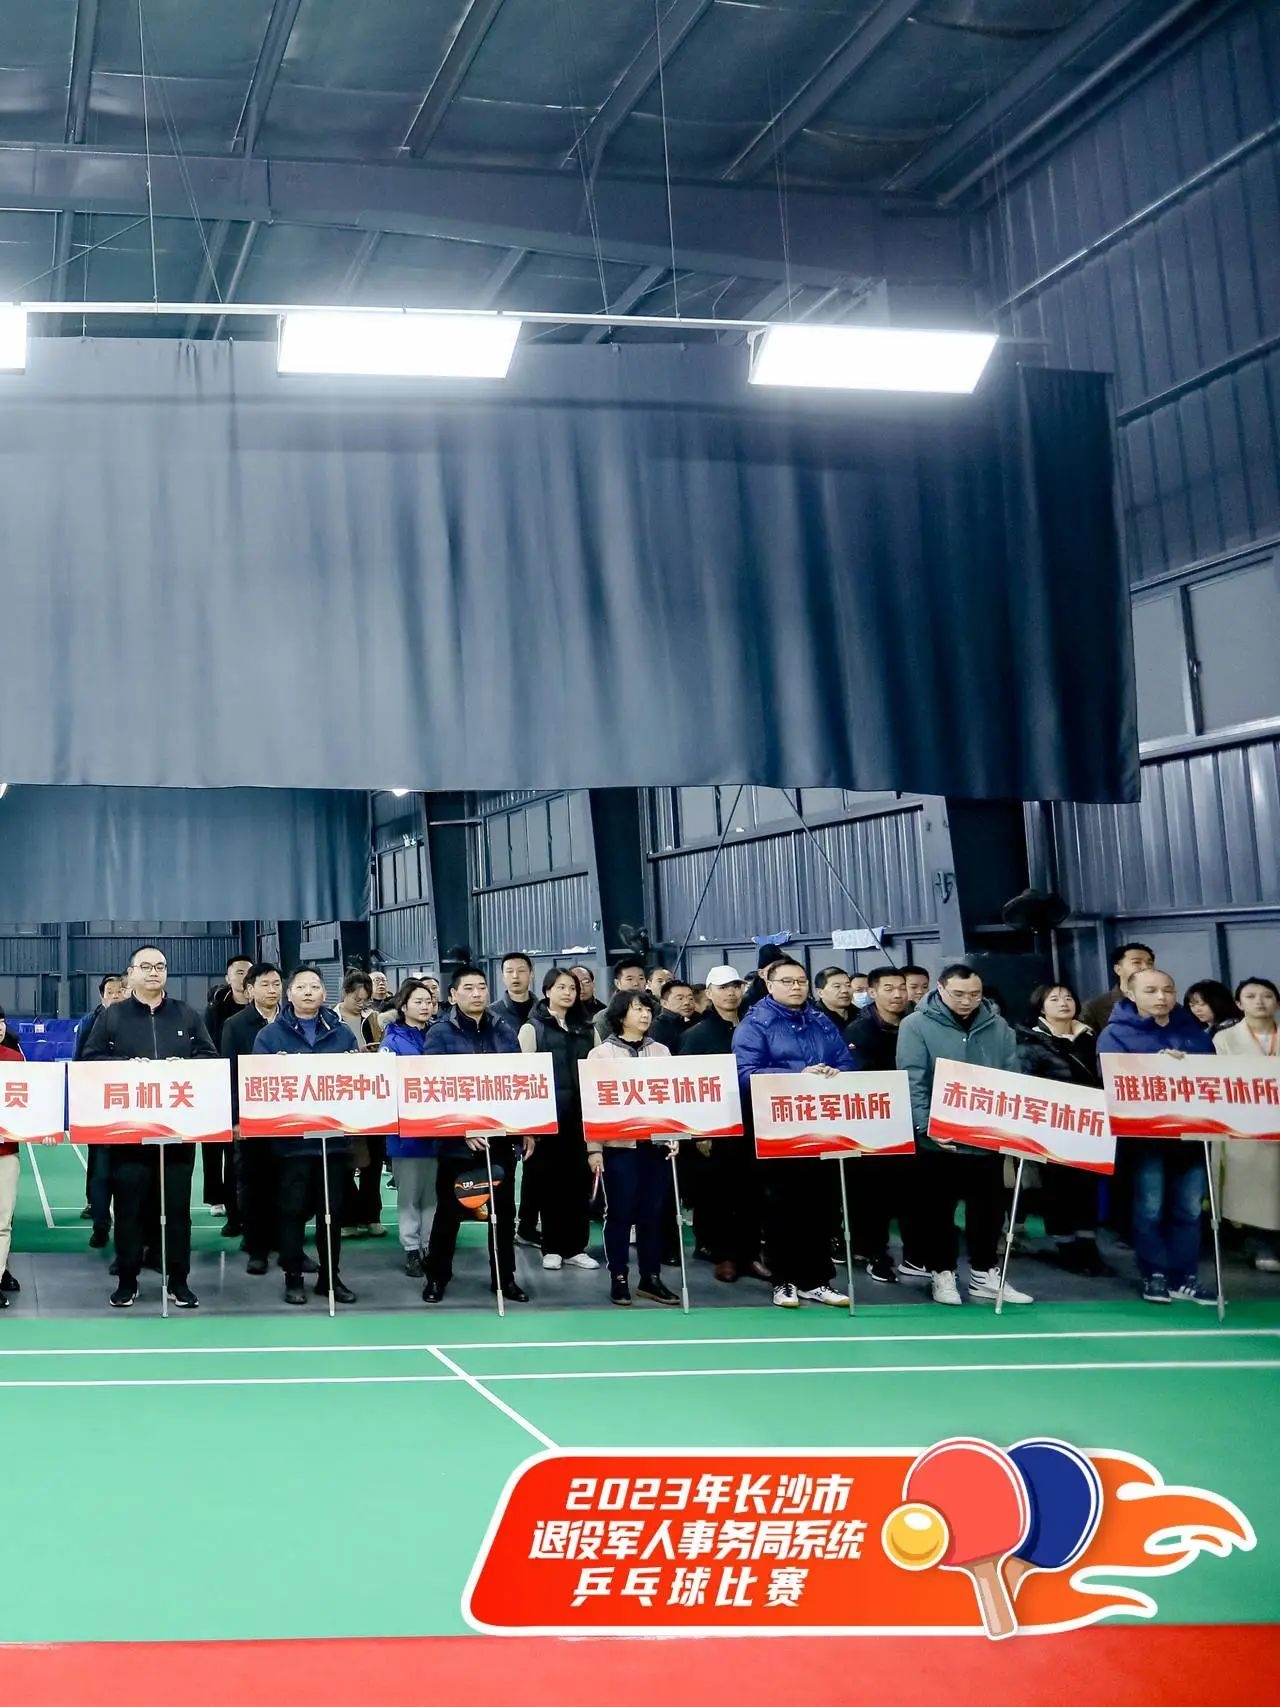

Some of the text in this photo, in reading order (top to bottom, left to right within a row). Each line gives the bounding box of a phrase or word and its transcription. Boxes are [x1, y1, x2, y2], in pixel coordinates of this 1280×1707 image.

[103, 1082, 195, 1109] 局机关
[244, 1074, 390, 1102] 退役军人服务中心
[403, 1074, 550, 1103] 局关祠军休服务站
[596, 1076, 722, 1106] 星火军休所
[1113, 1074, 1280, 1105] 雅塘冲军休所
[770, 1092, 892, 1122] 雨花军休所
[942, 1081, 1106, 1138] 赤岗村军休所
